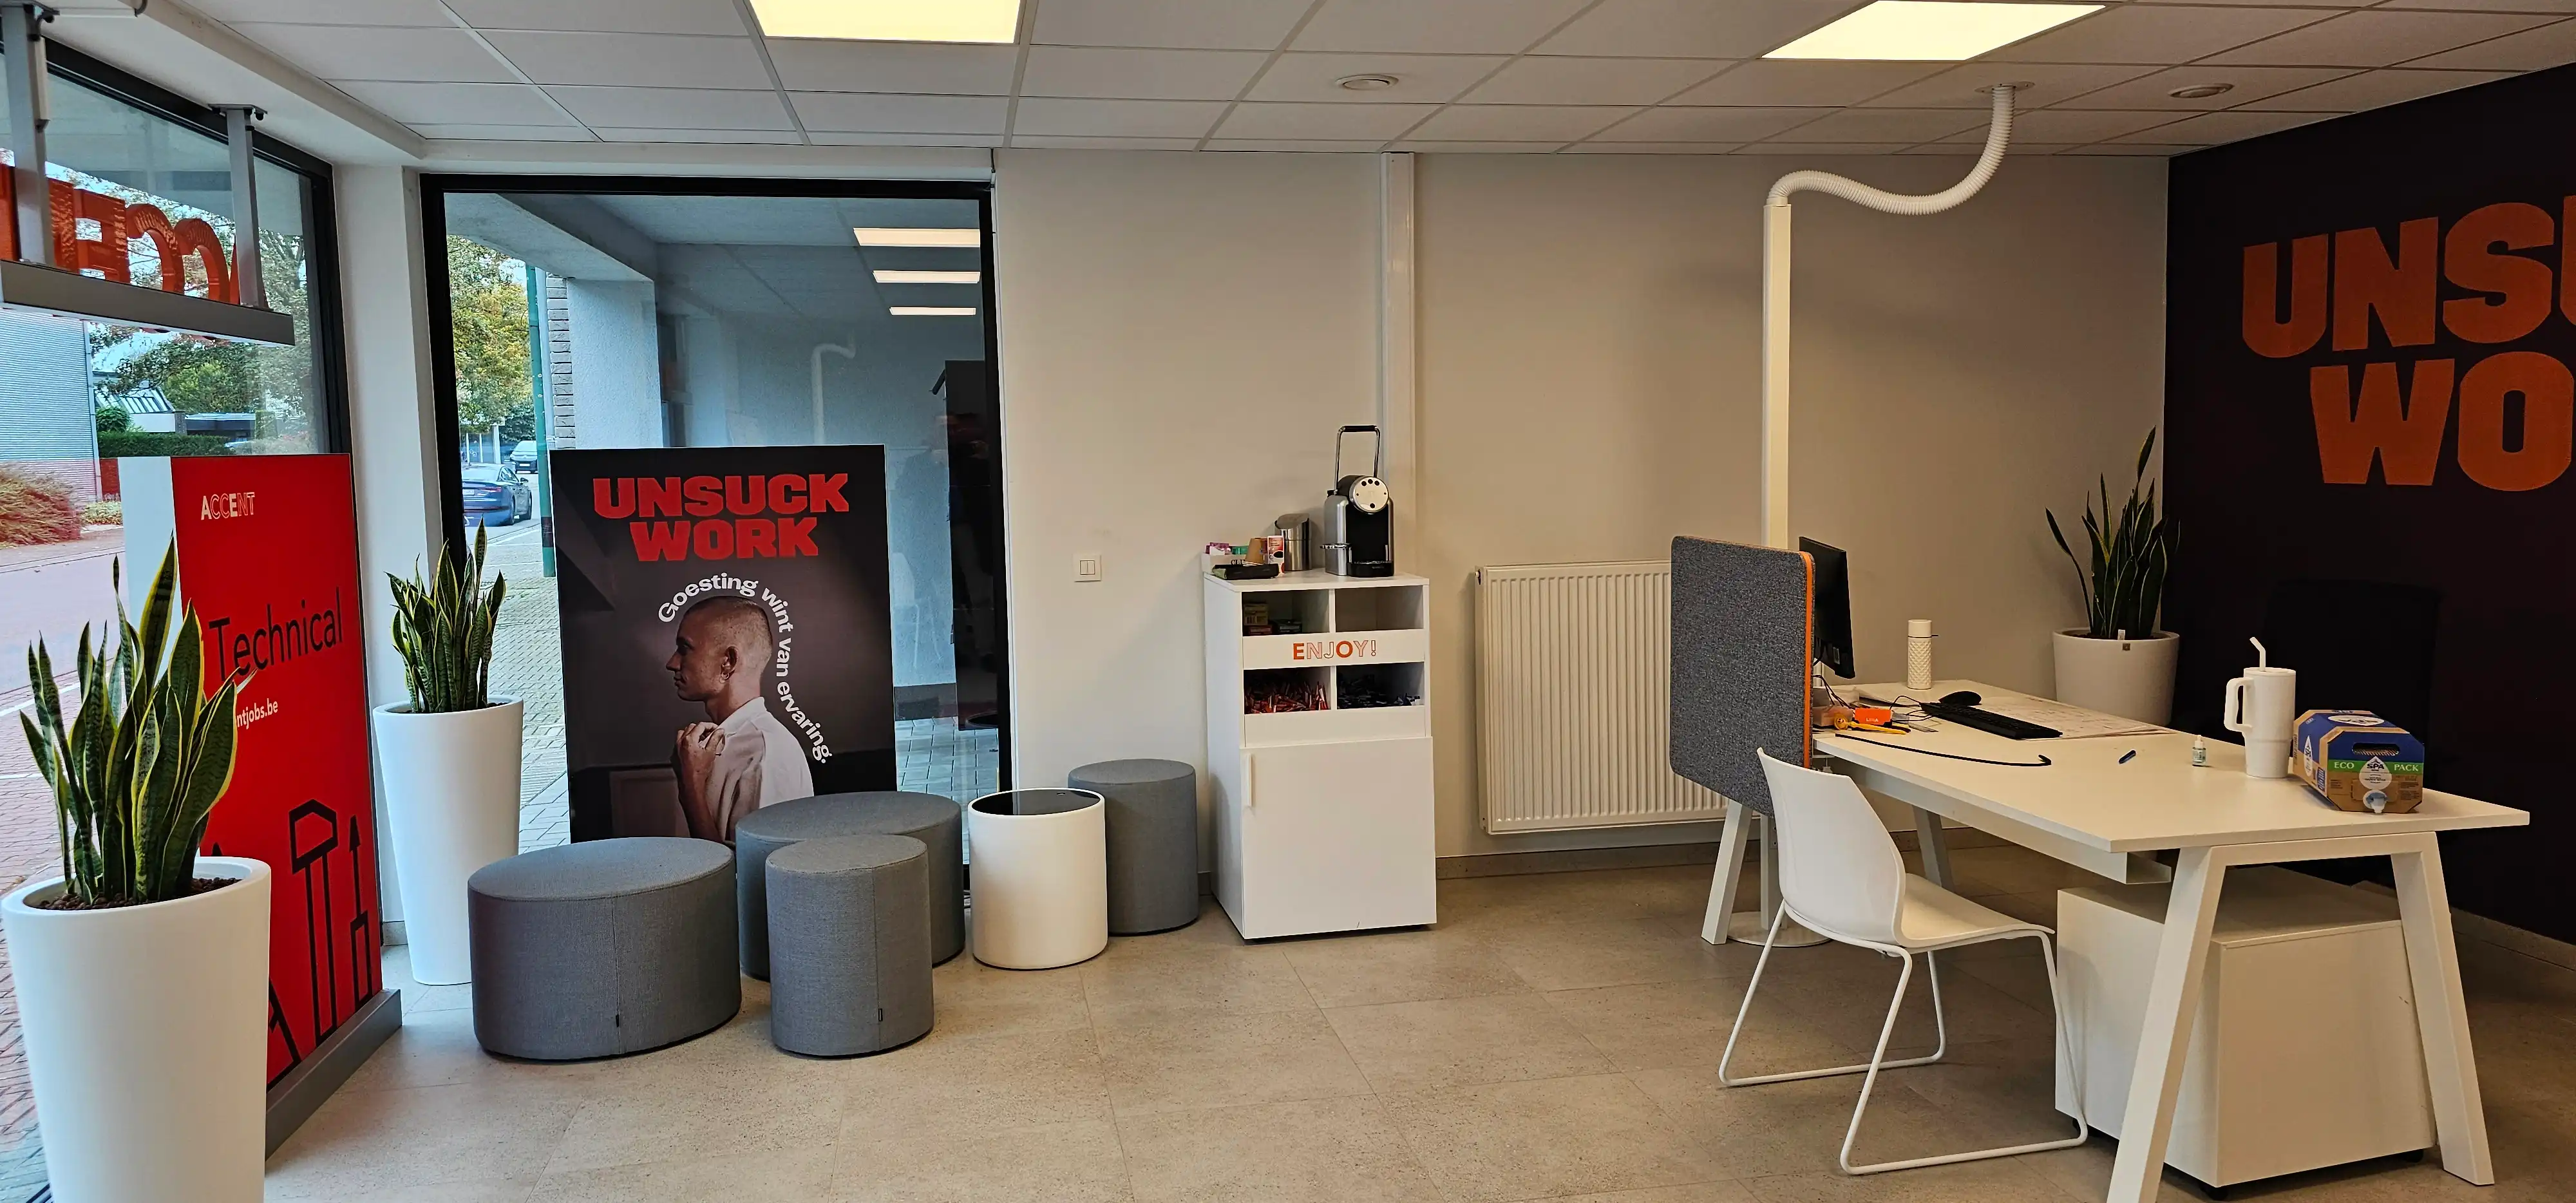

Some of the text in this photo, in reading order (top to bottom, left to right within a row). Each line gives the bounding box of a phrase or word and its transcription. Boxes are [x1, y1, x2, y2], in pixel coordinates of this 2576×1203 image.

[2242, 194, 2576, 358] UNS
[2310, 351, 2575, 491] WO
[200, 491, 256, 520] ACCENT
[592, 473, 849, 519] UNSUCK
[630, 517, 819, 562] WORK
[208, 586, 343, 682] Technical
[1293, 639, 1377, 660] ENJOY!
[658, 572, 833, 764] Goesting wint van ervaring.
[236, 697, 278, 730] ntjobs.be
[2334, 761, 2354, 770] ECO
[2394, 763, 2419, 772] PACK
